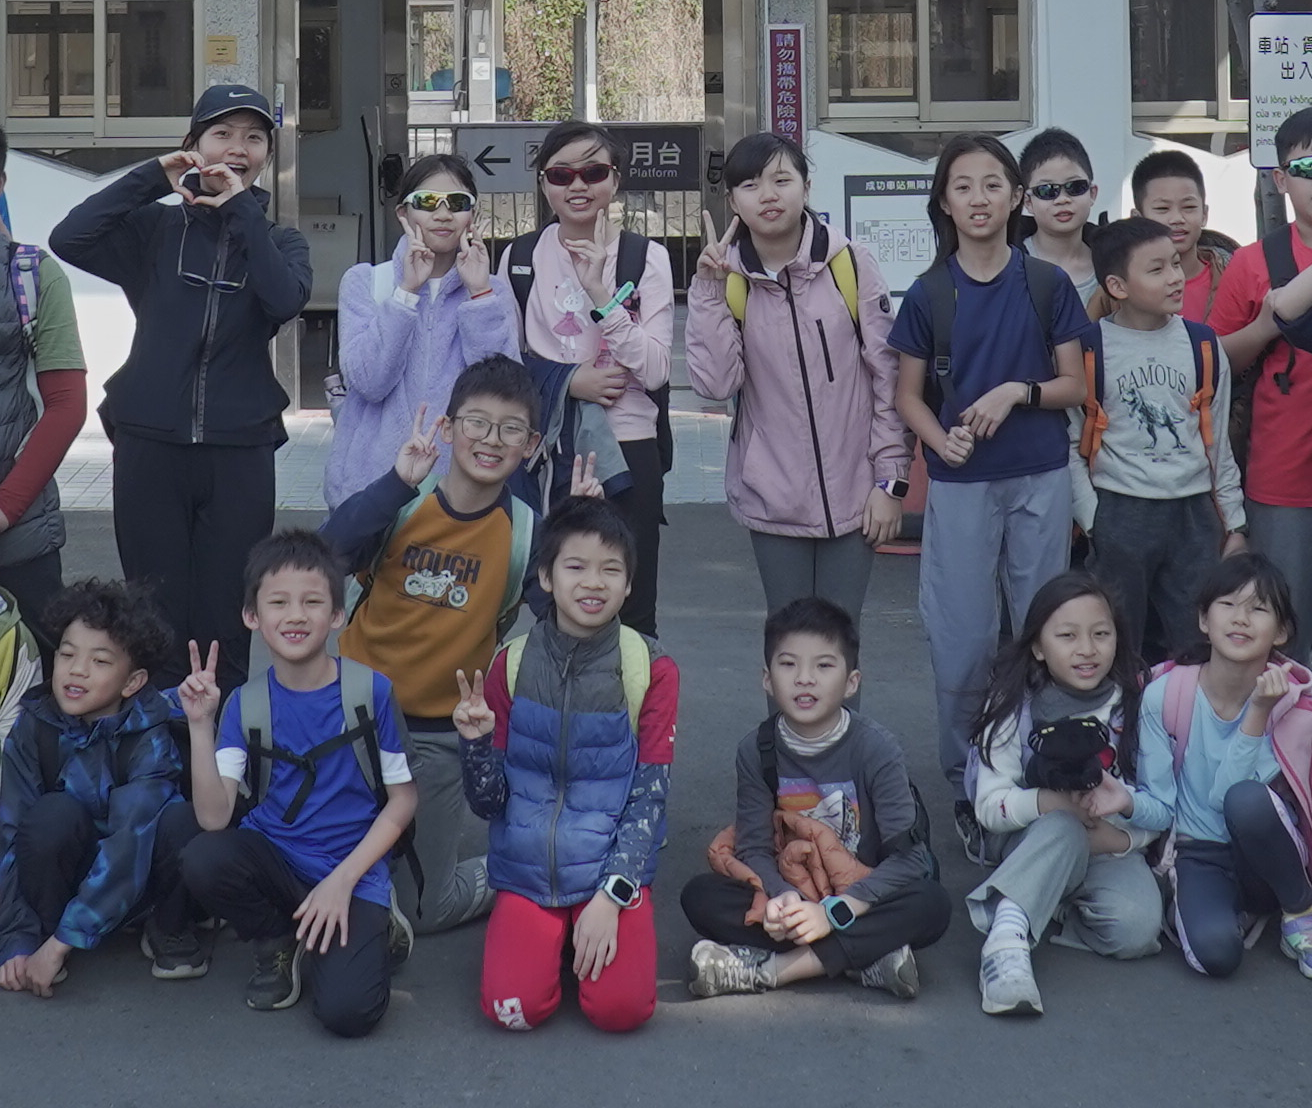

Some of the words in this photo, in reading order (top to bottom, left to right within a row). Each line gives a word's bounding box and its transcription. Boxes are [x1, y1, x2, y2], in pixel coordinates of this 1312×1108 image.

[630, 142, 682, 166] 月台
[629, 168, 678, 178] Platform
[1116, 364, 1187, 396] FAMOUS
[402, 545, 482, 584] ROUGH
